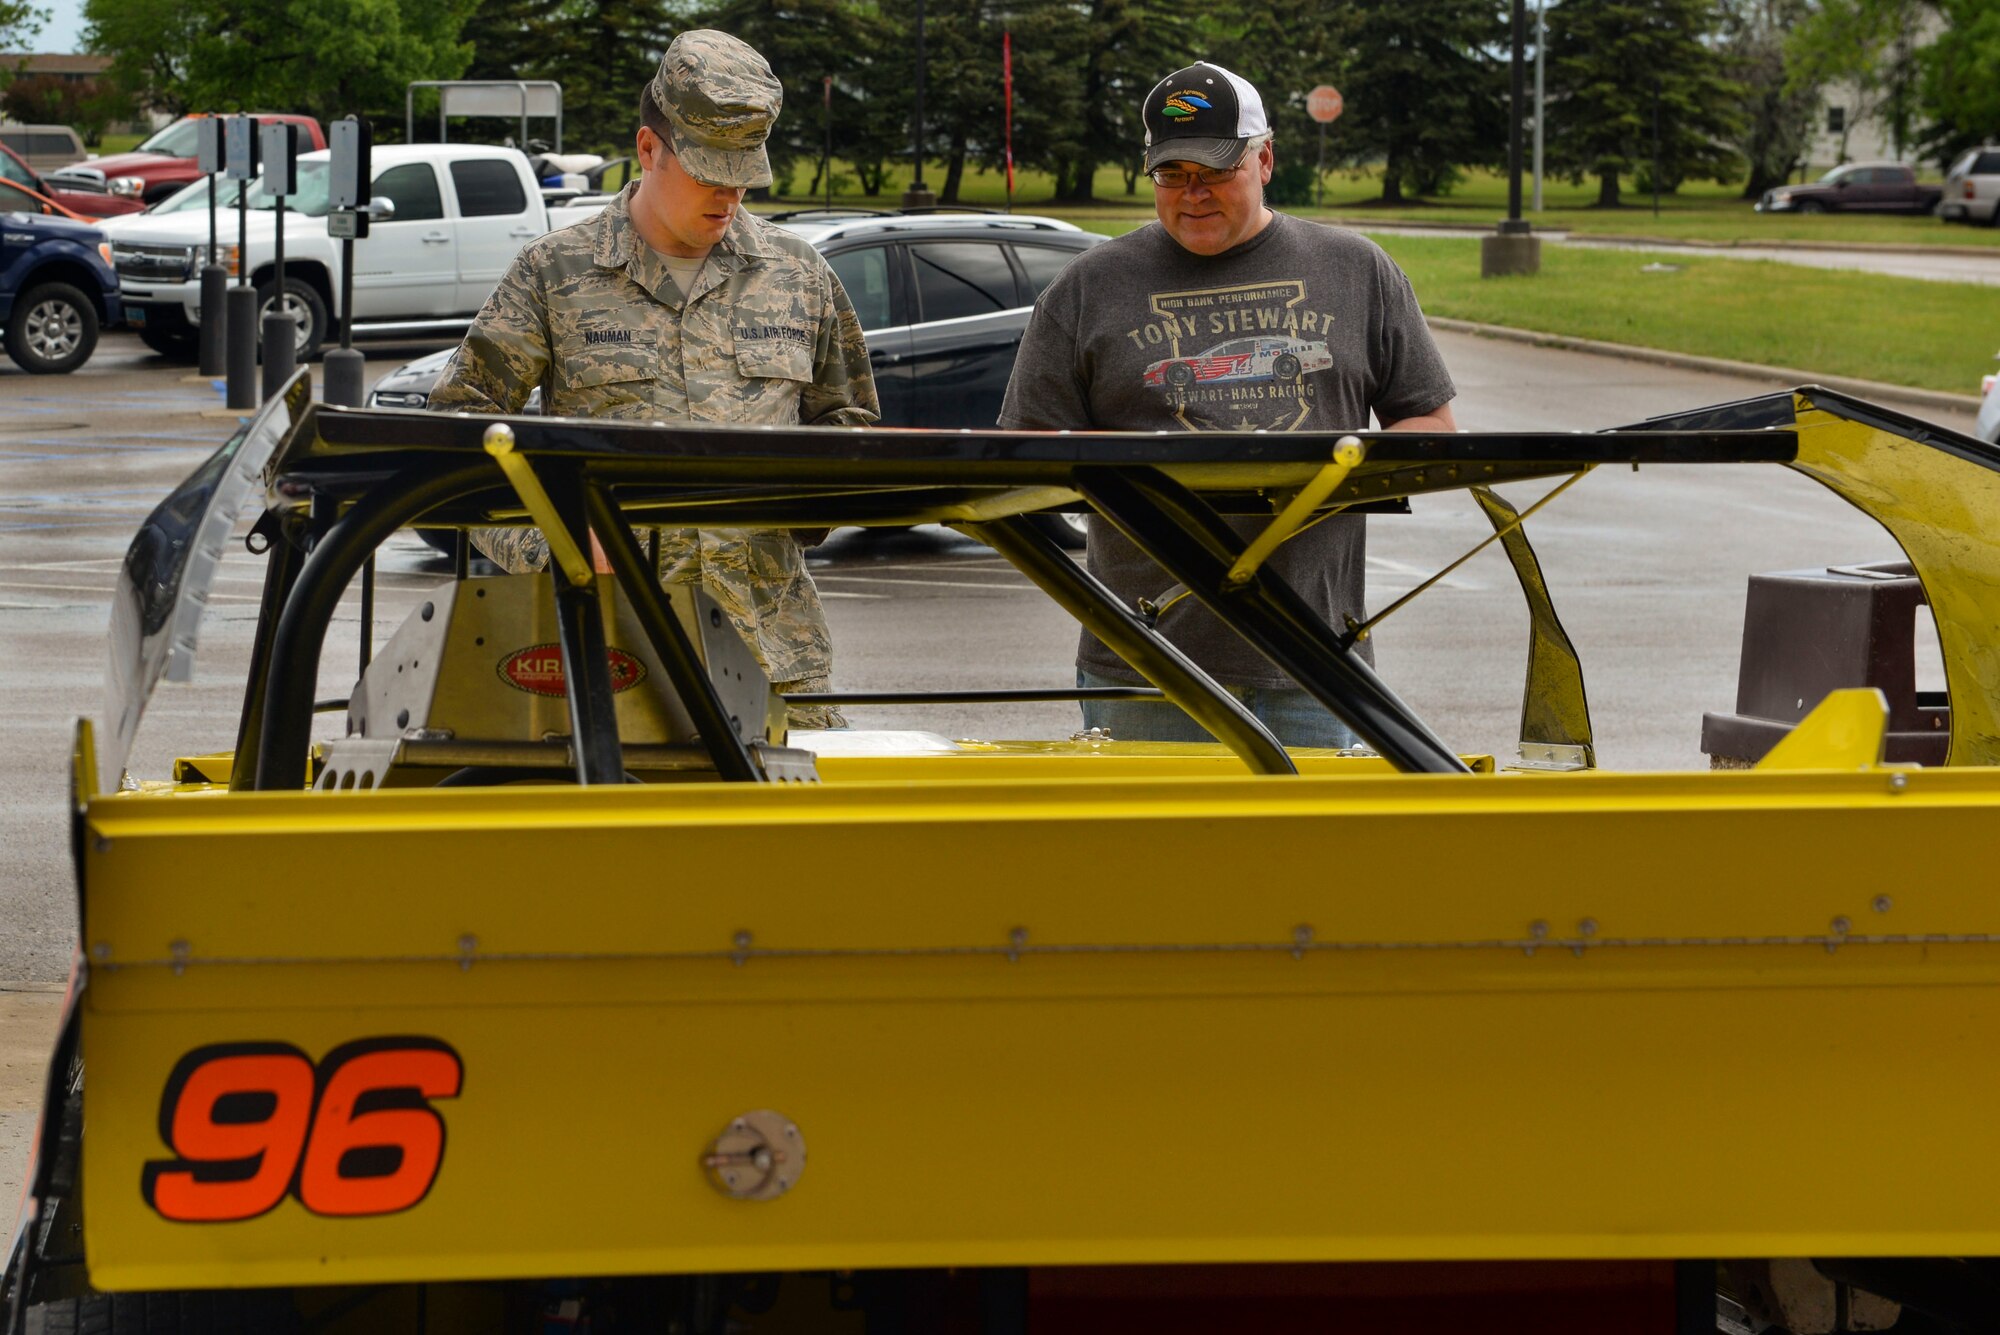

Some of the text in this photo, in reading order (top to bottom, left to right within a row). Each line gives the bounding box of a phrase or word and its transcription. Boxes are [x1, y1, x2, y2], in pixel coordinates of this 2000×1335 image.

[1309, 96, 1338, 112] STOP
[1161, 287, 1292, 309] HIGH BANK PERFORMANCE
[585, 329, 632, 345] NAUMAN
[741, 326, 806, 341] U.S. AIR FORCE
[1127, 307, 1335, 350] TONY STEWART
[1229, 354, 1256, 376] 14
[1165, 383, 1315, 406] STEWART-HAAS RACING
[141, 1034, 465, 1224] 96
